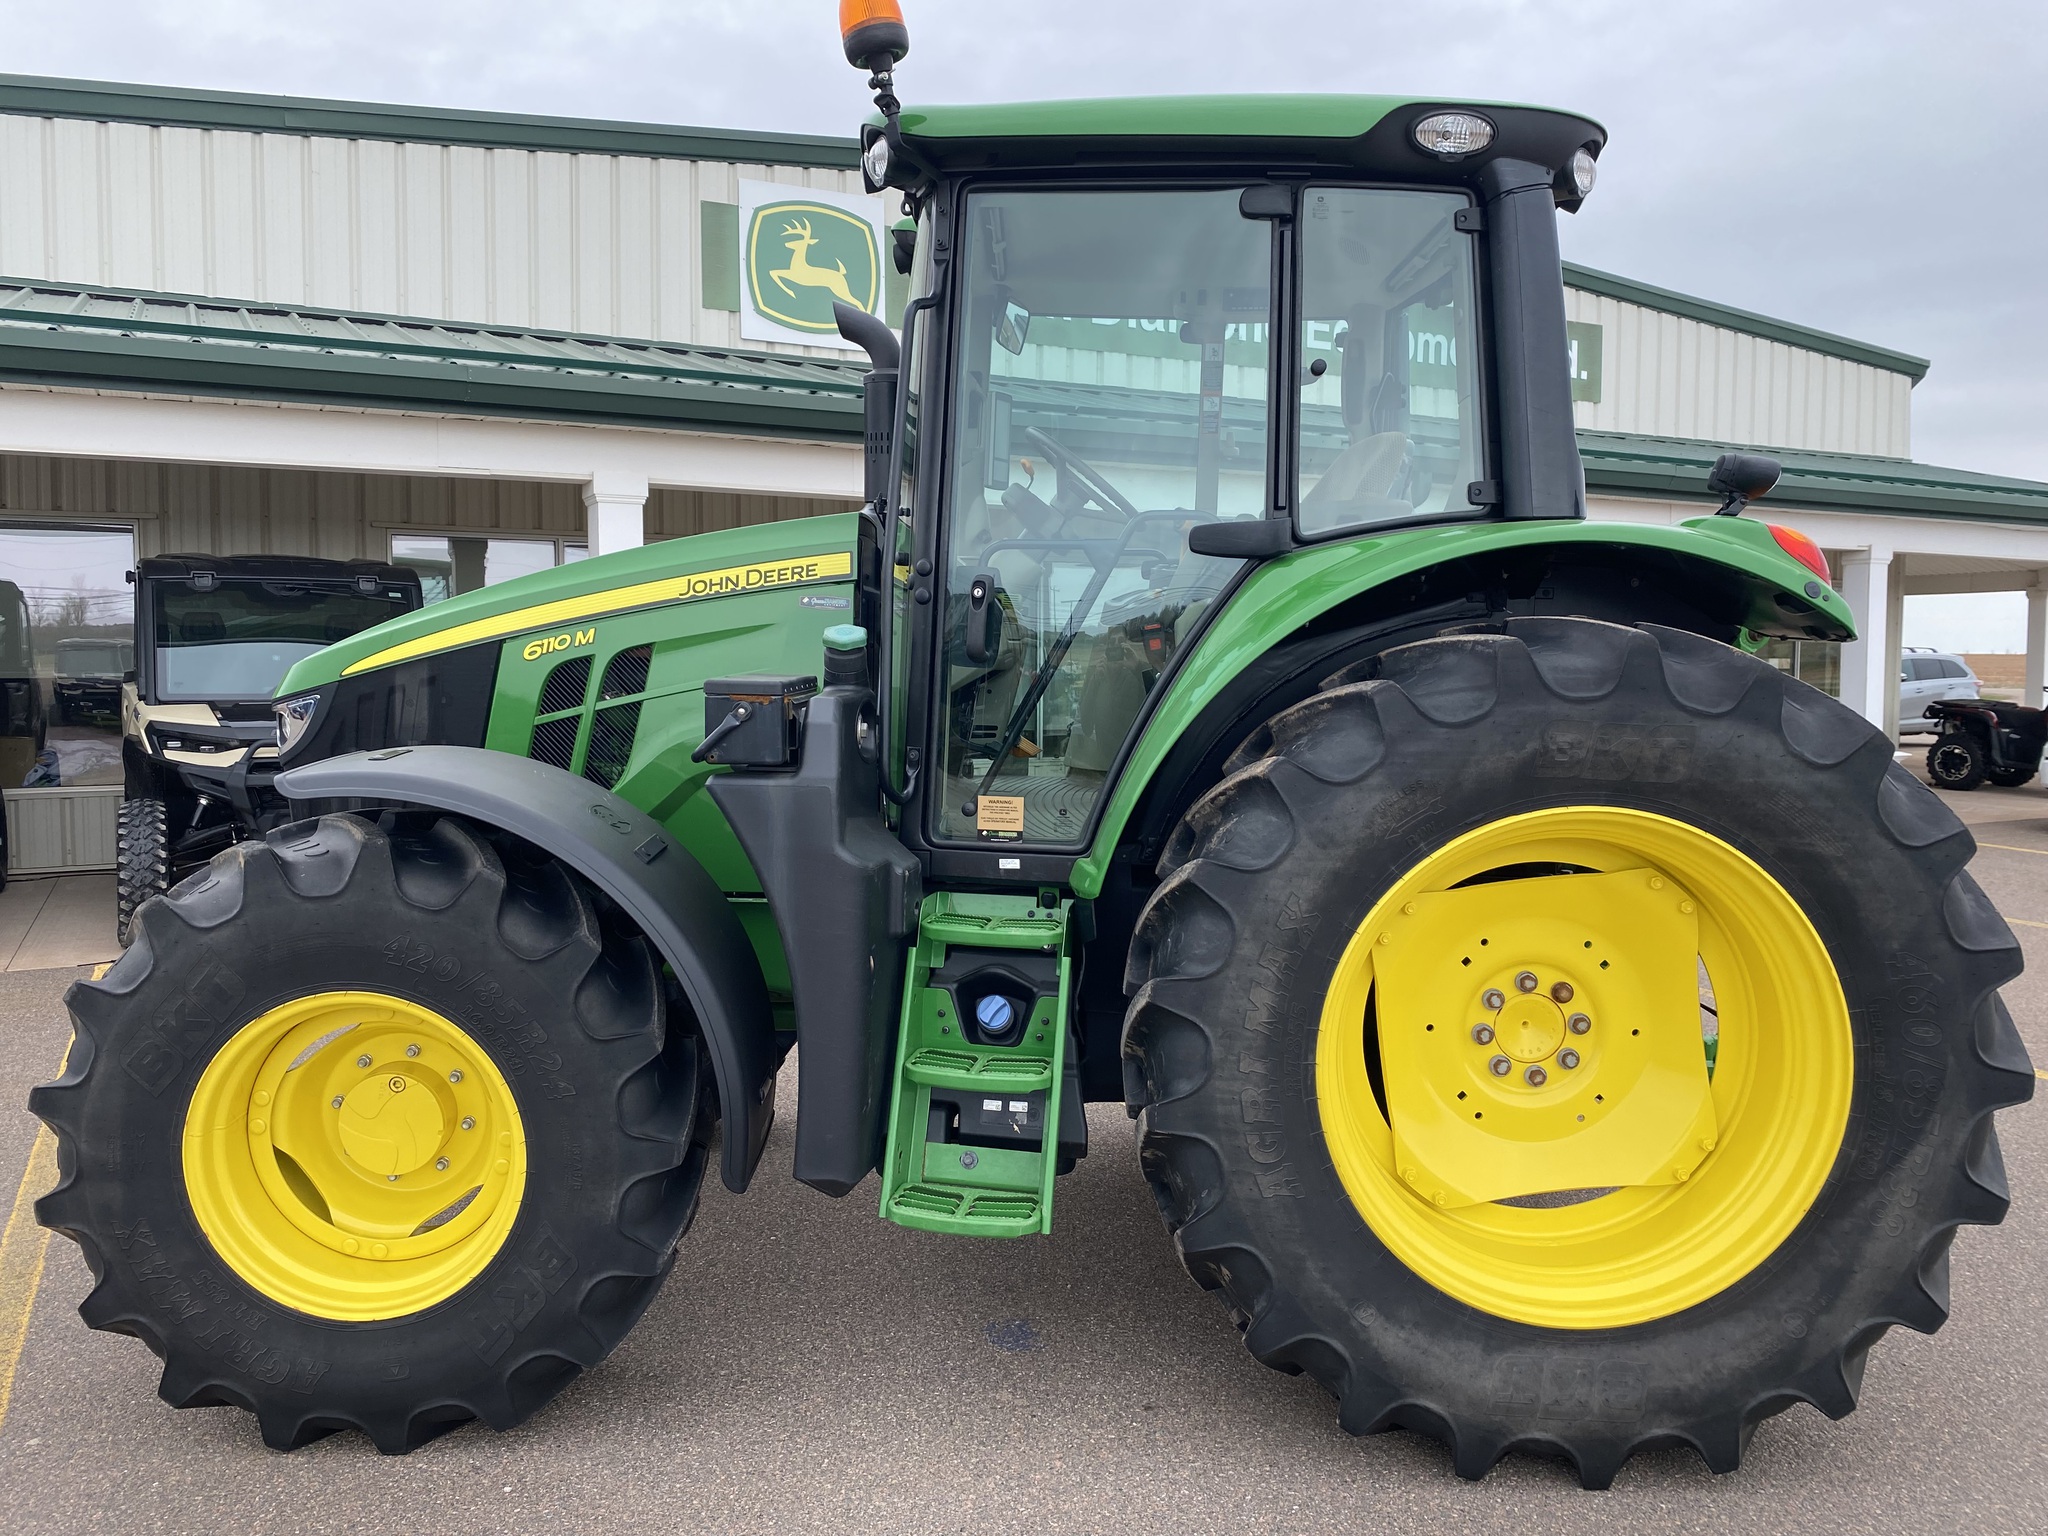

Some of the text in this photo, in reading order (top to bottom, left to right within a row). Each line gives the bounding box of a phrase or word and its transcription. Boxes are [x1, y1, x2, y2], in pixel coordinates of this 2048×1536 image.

[523, 626, 597, 661] 6110 M
[678, 563, 819, 597] JOHN DEERE
[122, 953, 242, 1094] BKT
[383, 935, 577, 1099] 420/85R24
[1239, 891, 1322, 1199] AGRI MAX
[1868, 951, 1947, 1237] 460/85R38
[110, 1217, 333, 1395] AGRI MAX
[462, 1225, 577, 1363] BKT
